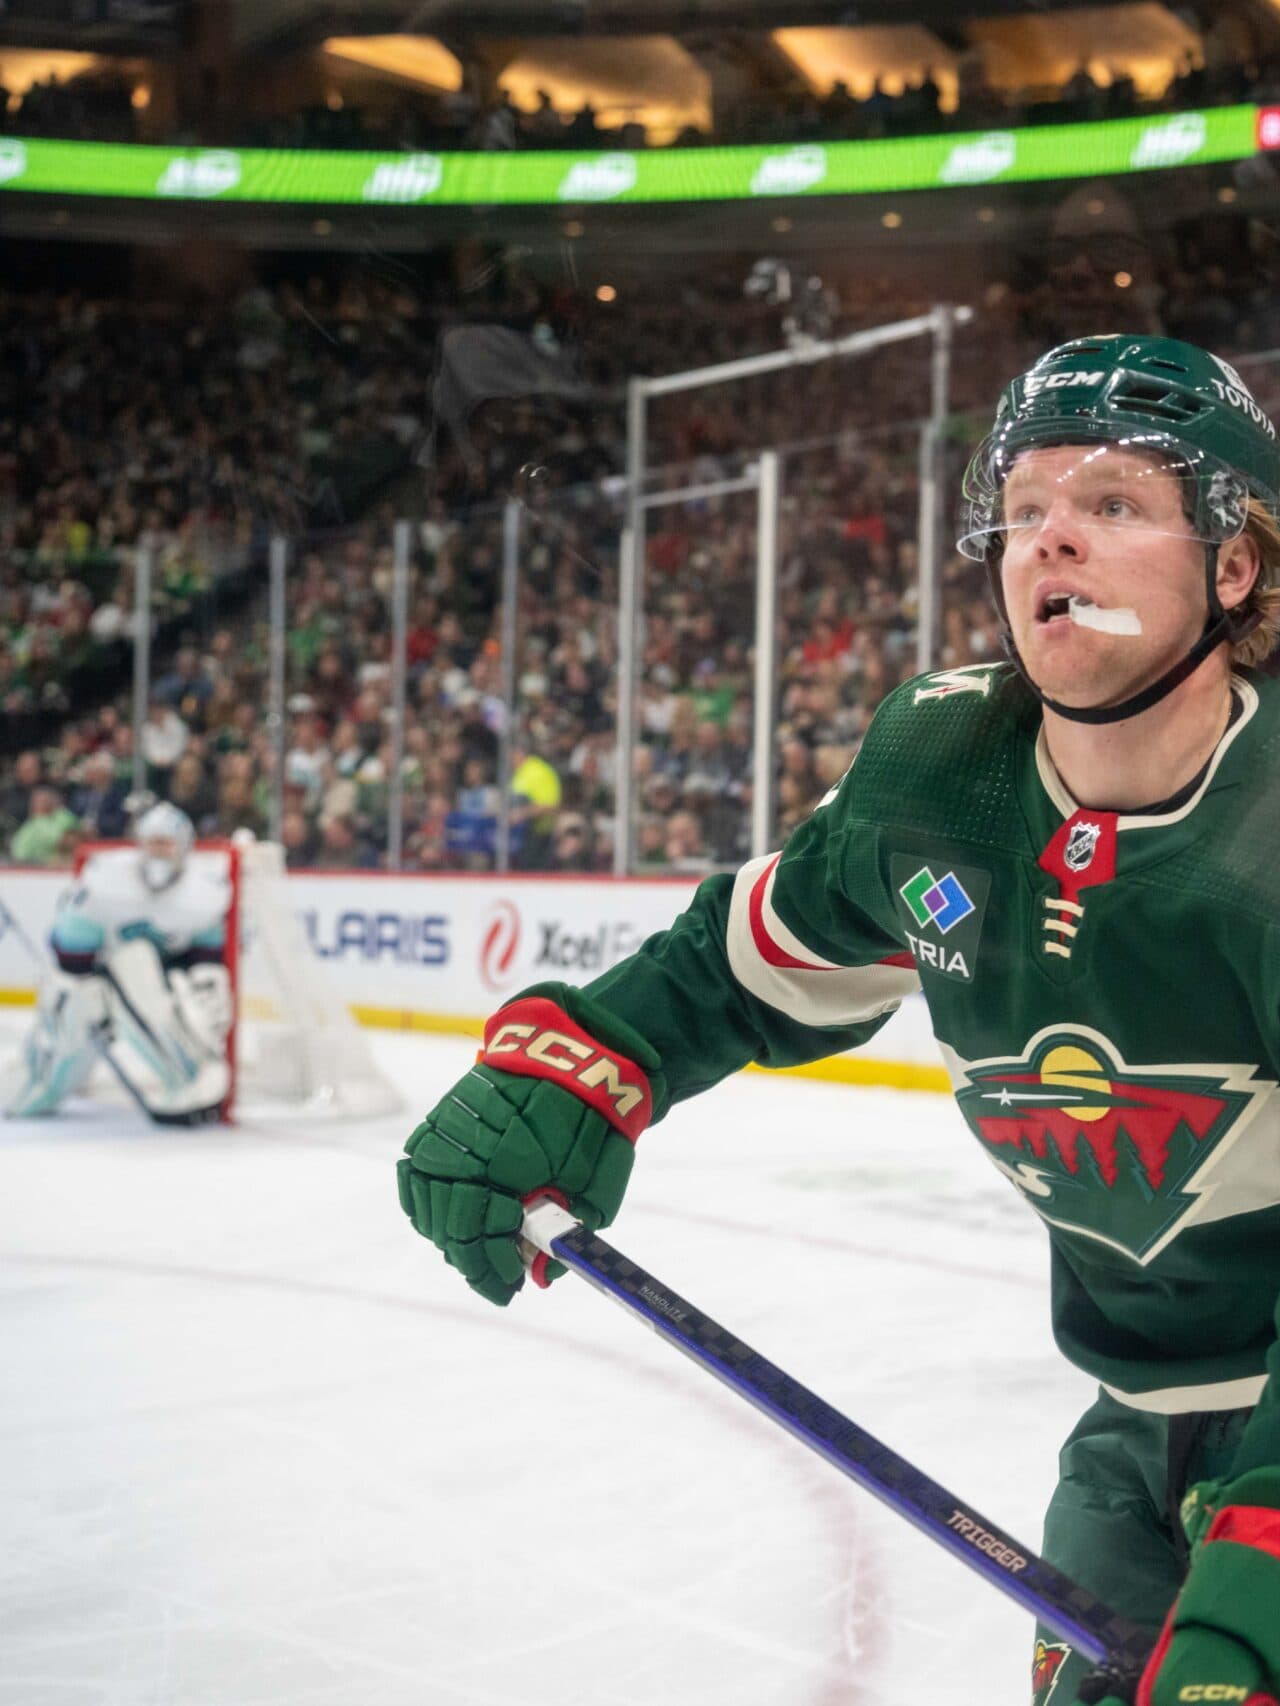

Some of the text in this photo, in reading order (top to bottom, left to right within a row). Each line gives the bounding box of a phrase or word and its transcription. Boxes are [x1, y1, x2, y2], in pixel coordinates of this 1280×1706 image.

[1023, 371, 1105, 395] CCM
[1210, 378, 1276, 440] TOYOTA
[303, 908, 452, 967] LARIS
[904, 930, 970, 978] TRIA
[487, 1024, 645, 1118] CCM
[946, 1510, 1028, 1573] TRIGGER
